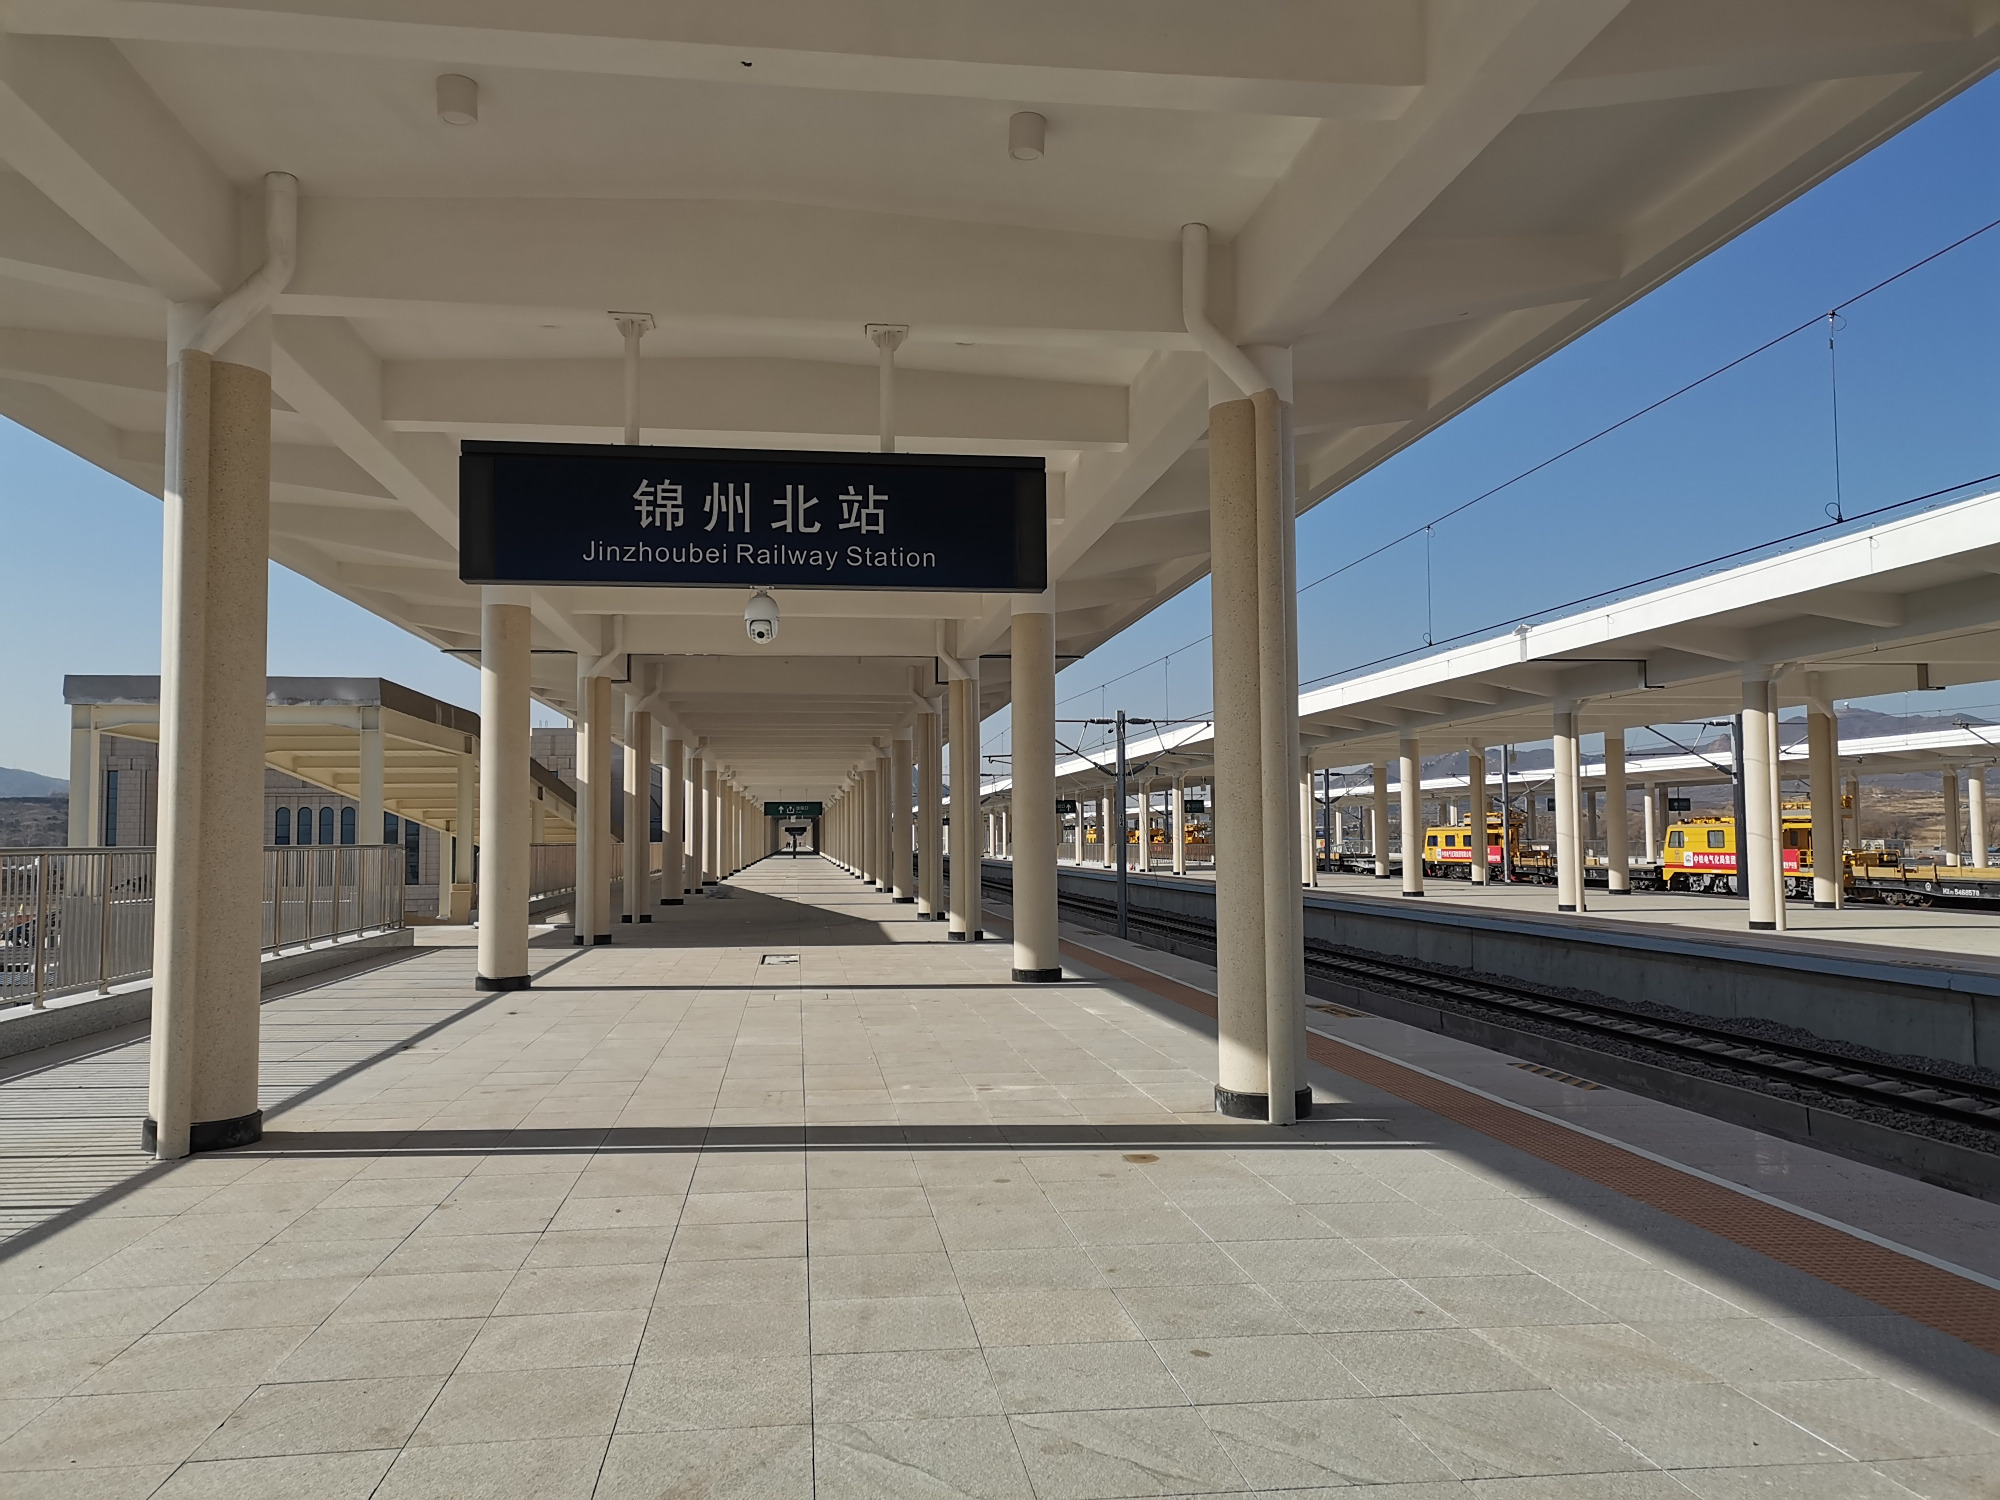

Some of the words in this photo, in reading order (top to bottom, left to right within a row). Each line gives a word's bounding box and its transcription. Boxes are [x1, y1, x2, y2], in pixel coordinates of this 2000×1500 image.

[632, 478, 889, 535] 锦州北站
[582, 540, 727, 564] Jinzhoubei
[736, 543, 838, 571] Railway
[846, 545, 936, 568] Station
